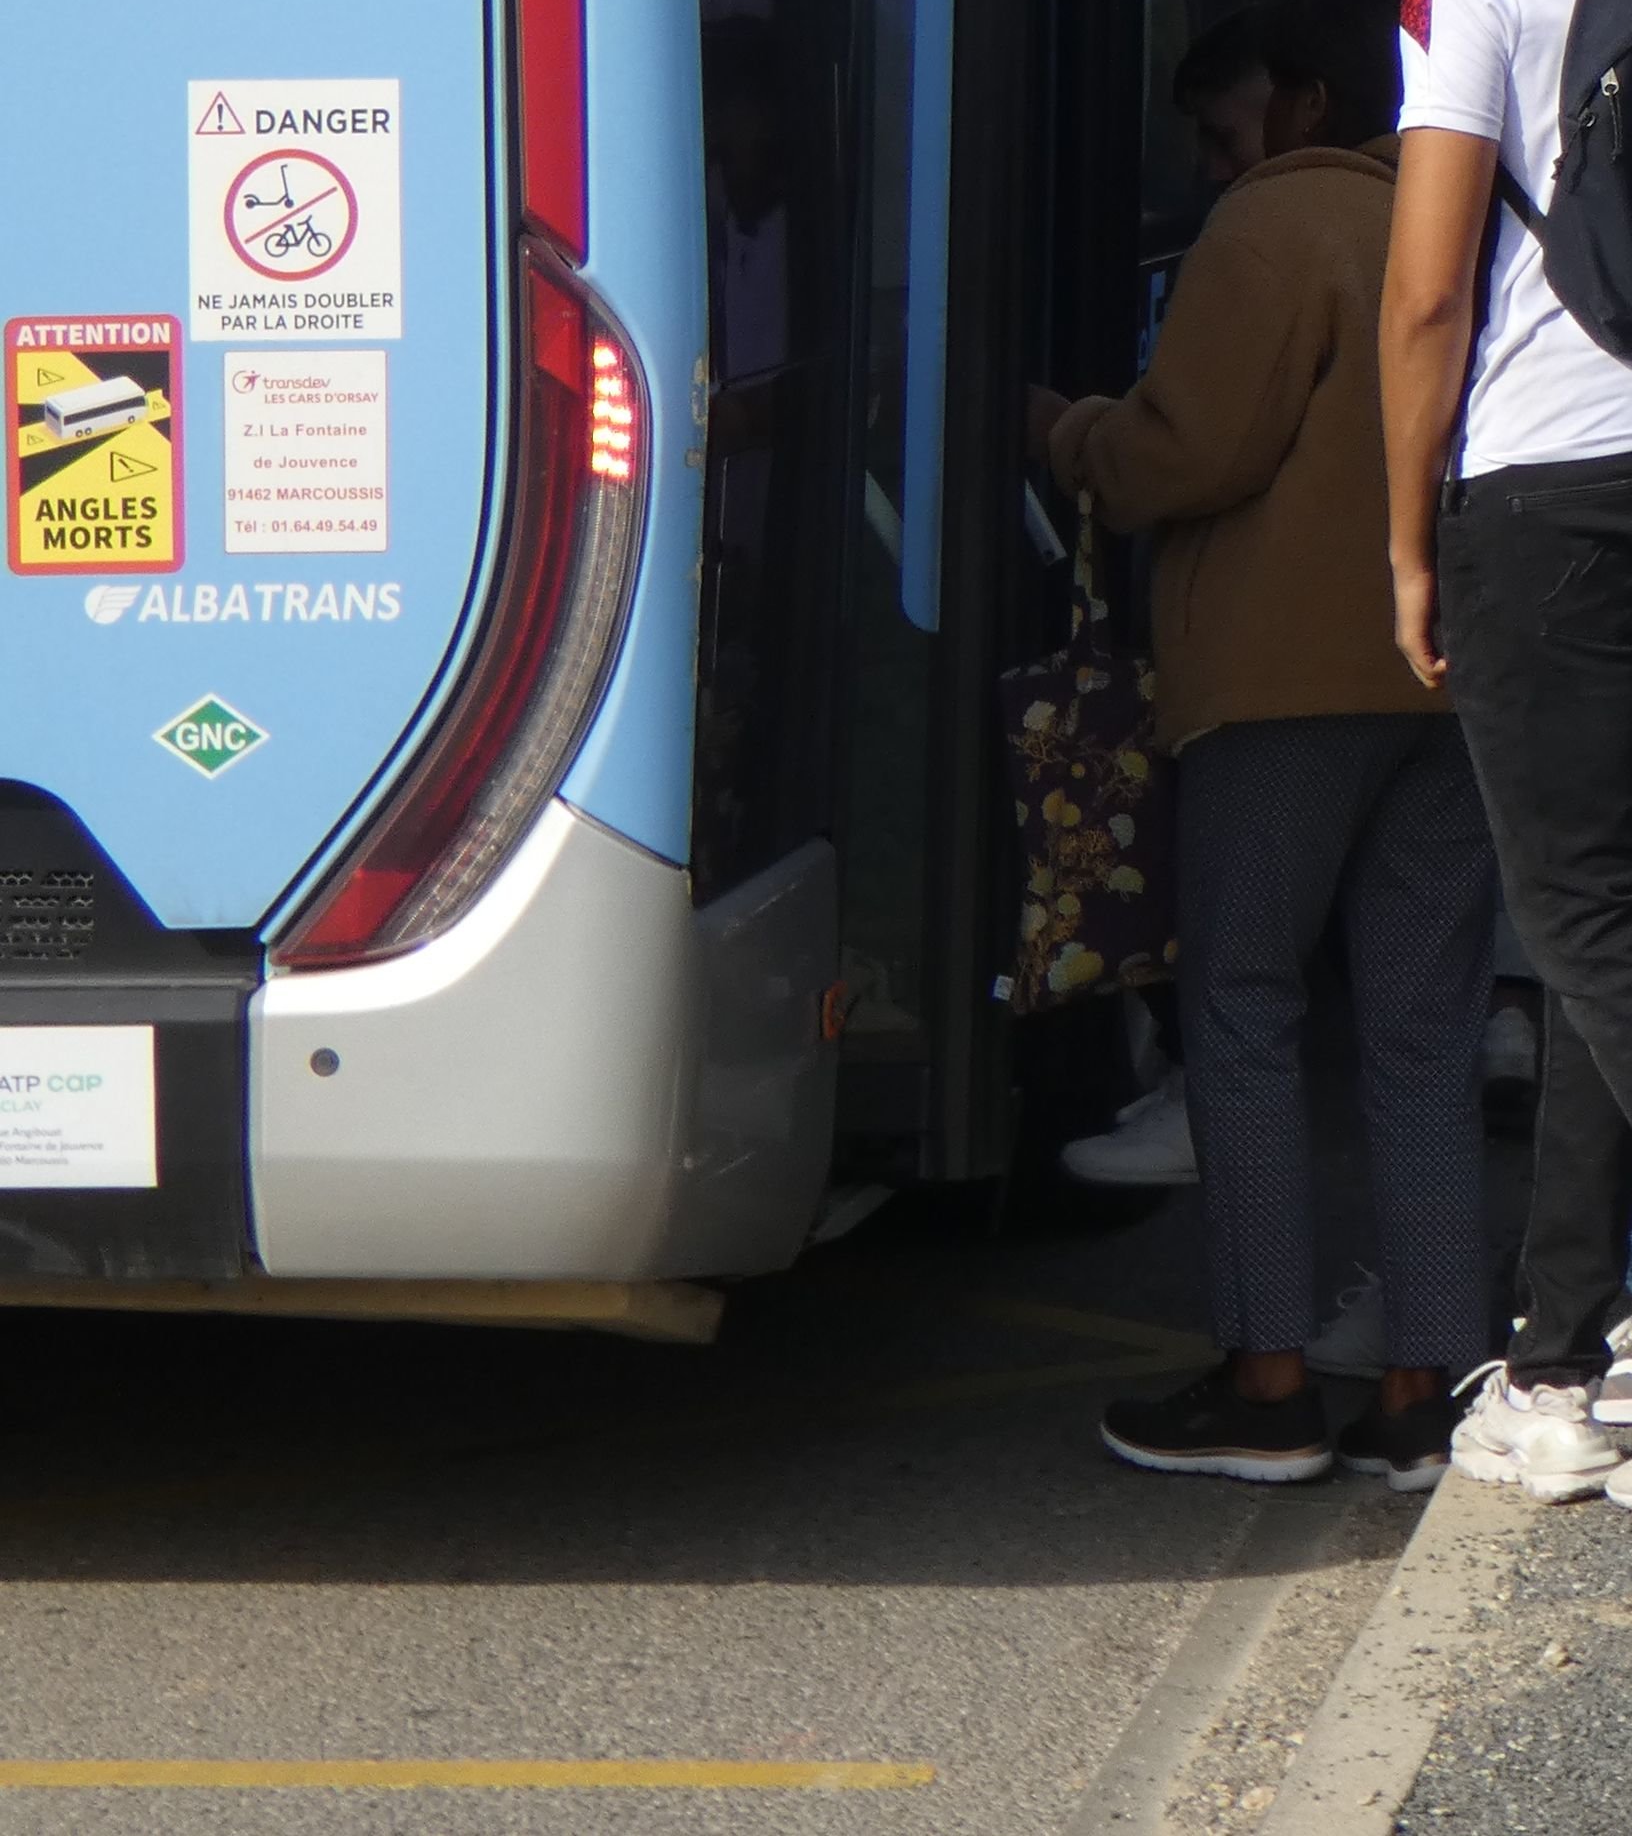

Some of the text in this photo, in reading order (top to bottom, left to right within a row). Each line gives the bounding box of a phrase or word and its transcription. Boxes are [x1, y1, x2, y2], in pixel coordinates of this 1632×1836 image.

[256, 109, 390, 134] DANGER
[198, 293, 394, 309] NE JAMAIS DOUBLER
[221, 314, 363, 330] PAR LA DROITE
[17, 322, 170, 346] ATTENTION
[262, 376, 331, 389] transdev
[264, 392, 379, 404] LES CARS D'ORSAY
[244, 423, 367, 437] Z.I La Fontaine
[253, 456, 358, 468] de Jouvence
[228, 487, 384, 500] 91462 MARCOUSSIS
[35, 497, 157, 522] ANGLES
[235, 521, 257, 533] Tél
[271, 519, 378, 533] 01.64.49.54.49
[43, 525, 153, 550] MORTS
[138, 583, 401, 623] ALBATRANS
[175, 722, 247, 752] GNC
